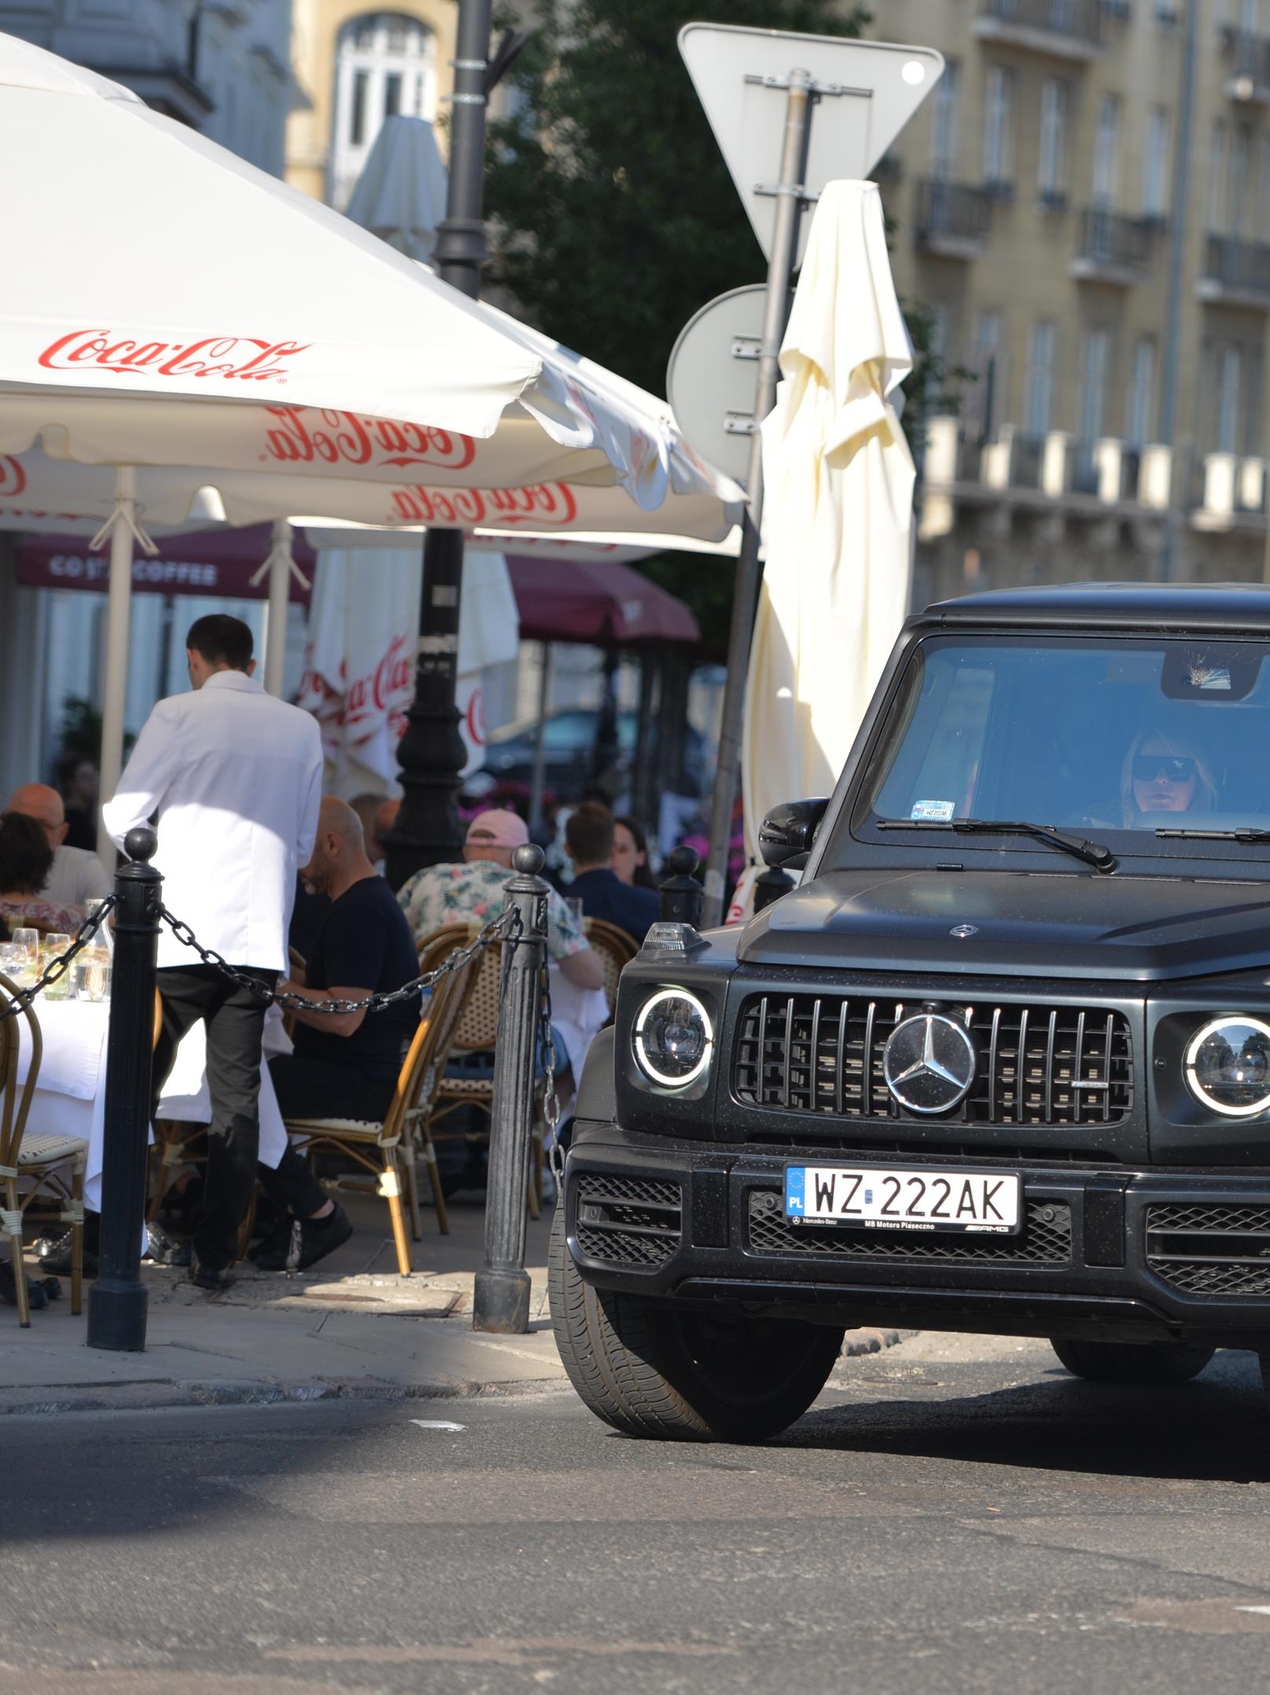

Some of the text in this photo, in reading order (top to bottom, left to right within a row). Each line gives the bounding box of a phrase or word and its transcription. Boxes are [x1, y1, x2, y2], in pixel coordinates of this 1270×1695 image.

[38, 329, 315, 381] Coca-Cola
[133, 561, 218, 586] COFFEE
[789, 1197, 803, 1209] PL
[815, 1173, 1005, 1220] WZ 222AK
[803, 1218, 837, 1226] Mercedes-Benz
[876, 1221, 900, 1229] Motors
[901, 1222, 935, 1231] Piaseczno
